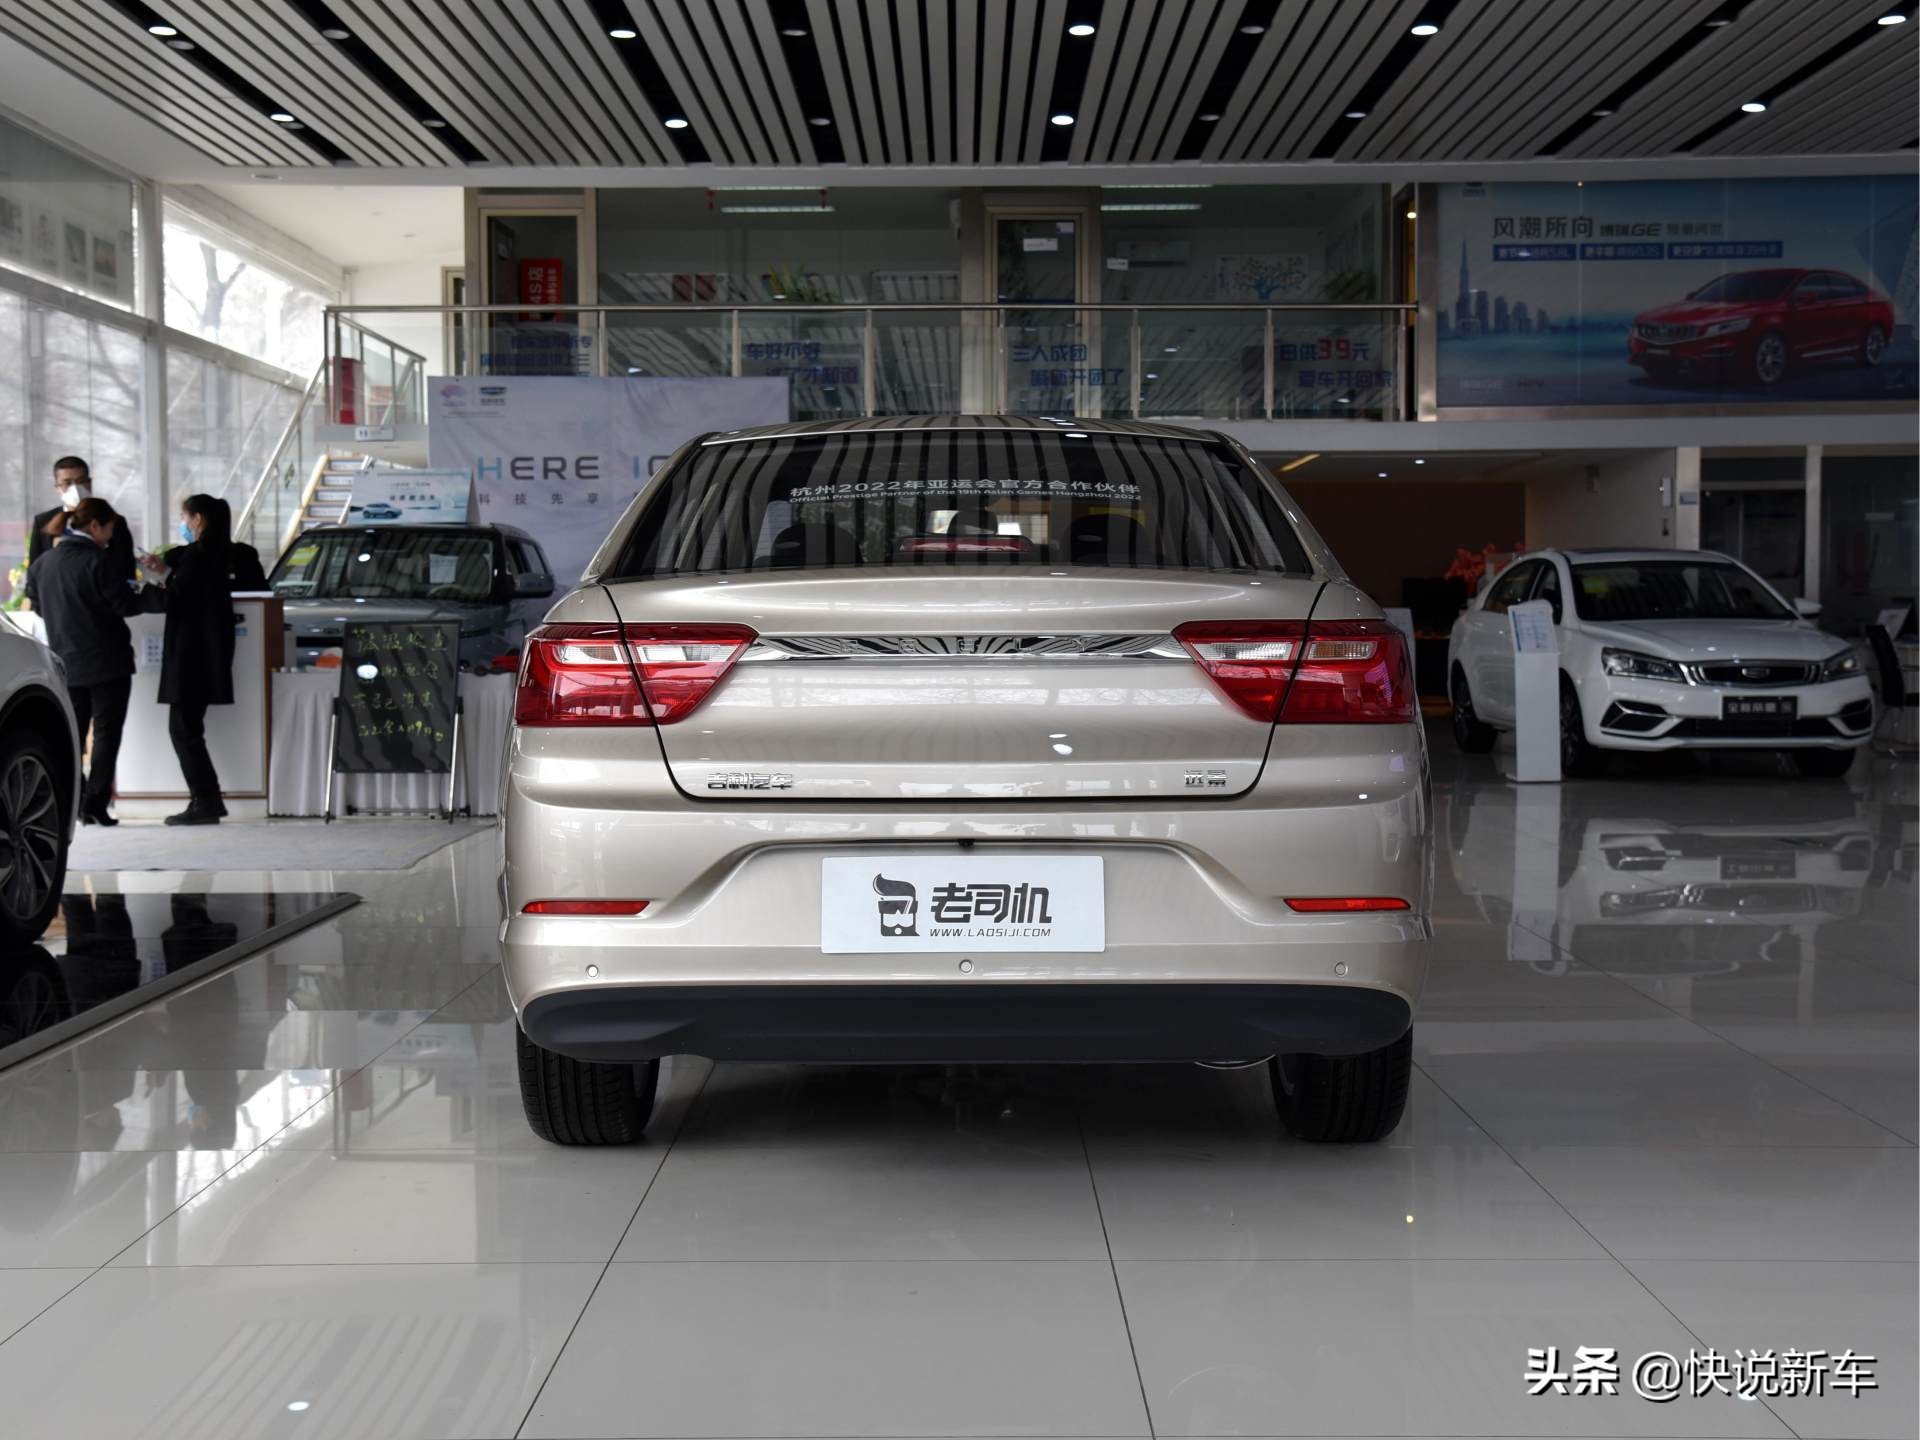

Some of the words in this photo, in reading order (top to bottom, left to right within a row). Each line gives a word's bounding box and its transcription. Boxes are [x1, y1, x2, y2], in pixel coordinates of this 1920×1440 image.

[1492, 216, 1593, 239] 风潮所向
[746, 342, 822, 361] 车好不好
[1012, 344, 1088, 362] 三人成团
[477, 455, 599, 480] HERE
[790, 479, 1141, 497] 杭州2022年亚运会官方合作伙伴
[790, 495, 830, 503] Official
[833, 491, 878, 499] Prestige
[1055, 490, 1112, 498] Hangzhou
[840, 636, 1090, 654] GEELY
[707, 772, 793, 790] 吉利汽车
[1184, 769, 1227, 788] 远景
[930, 882, 1052, 924] 老司机
[930, 928, 1051, 937] WWW.LAOSIJI.COM
